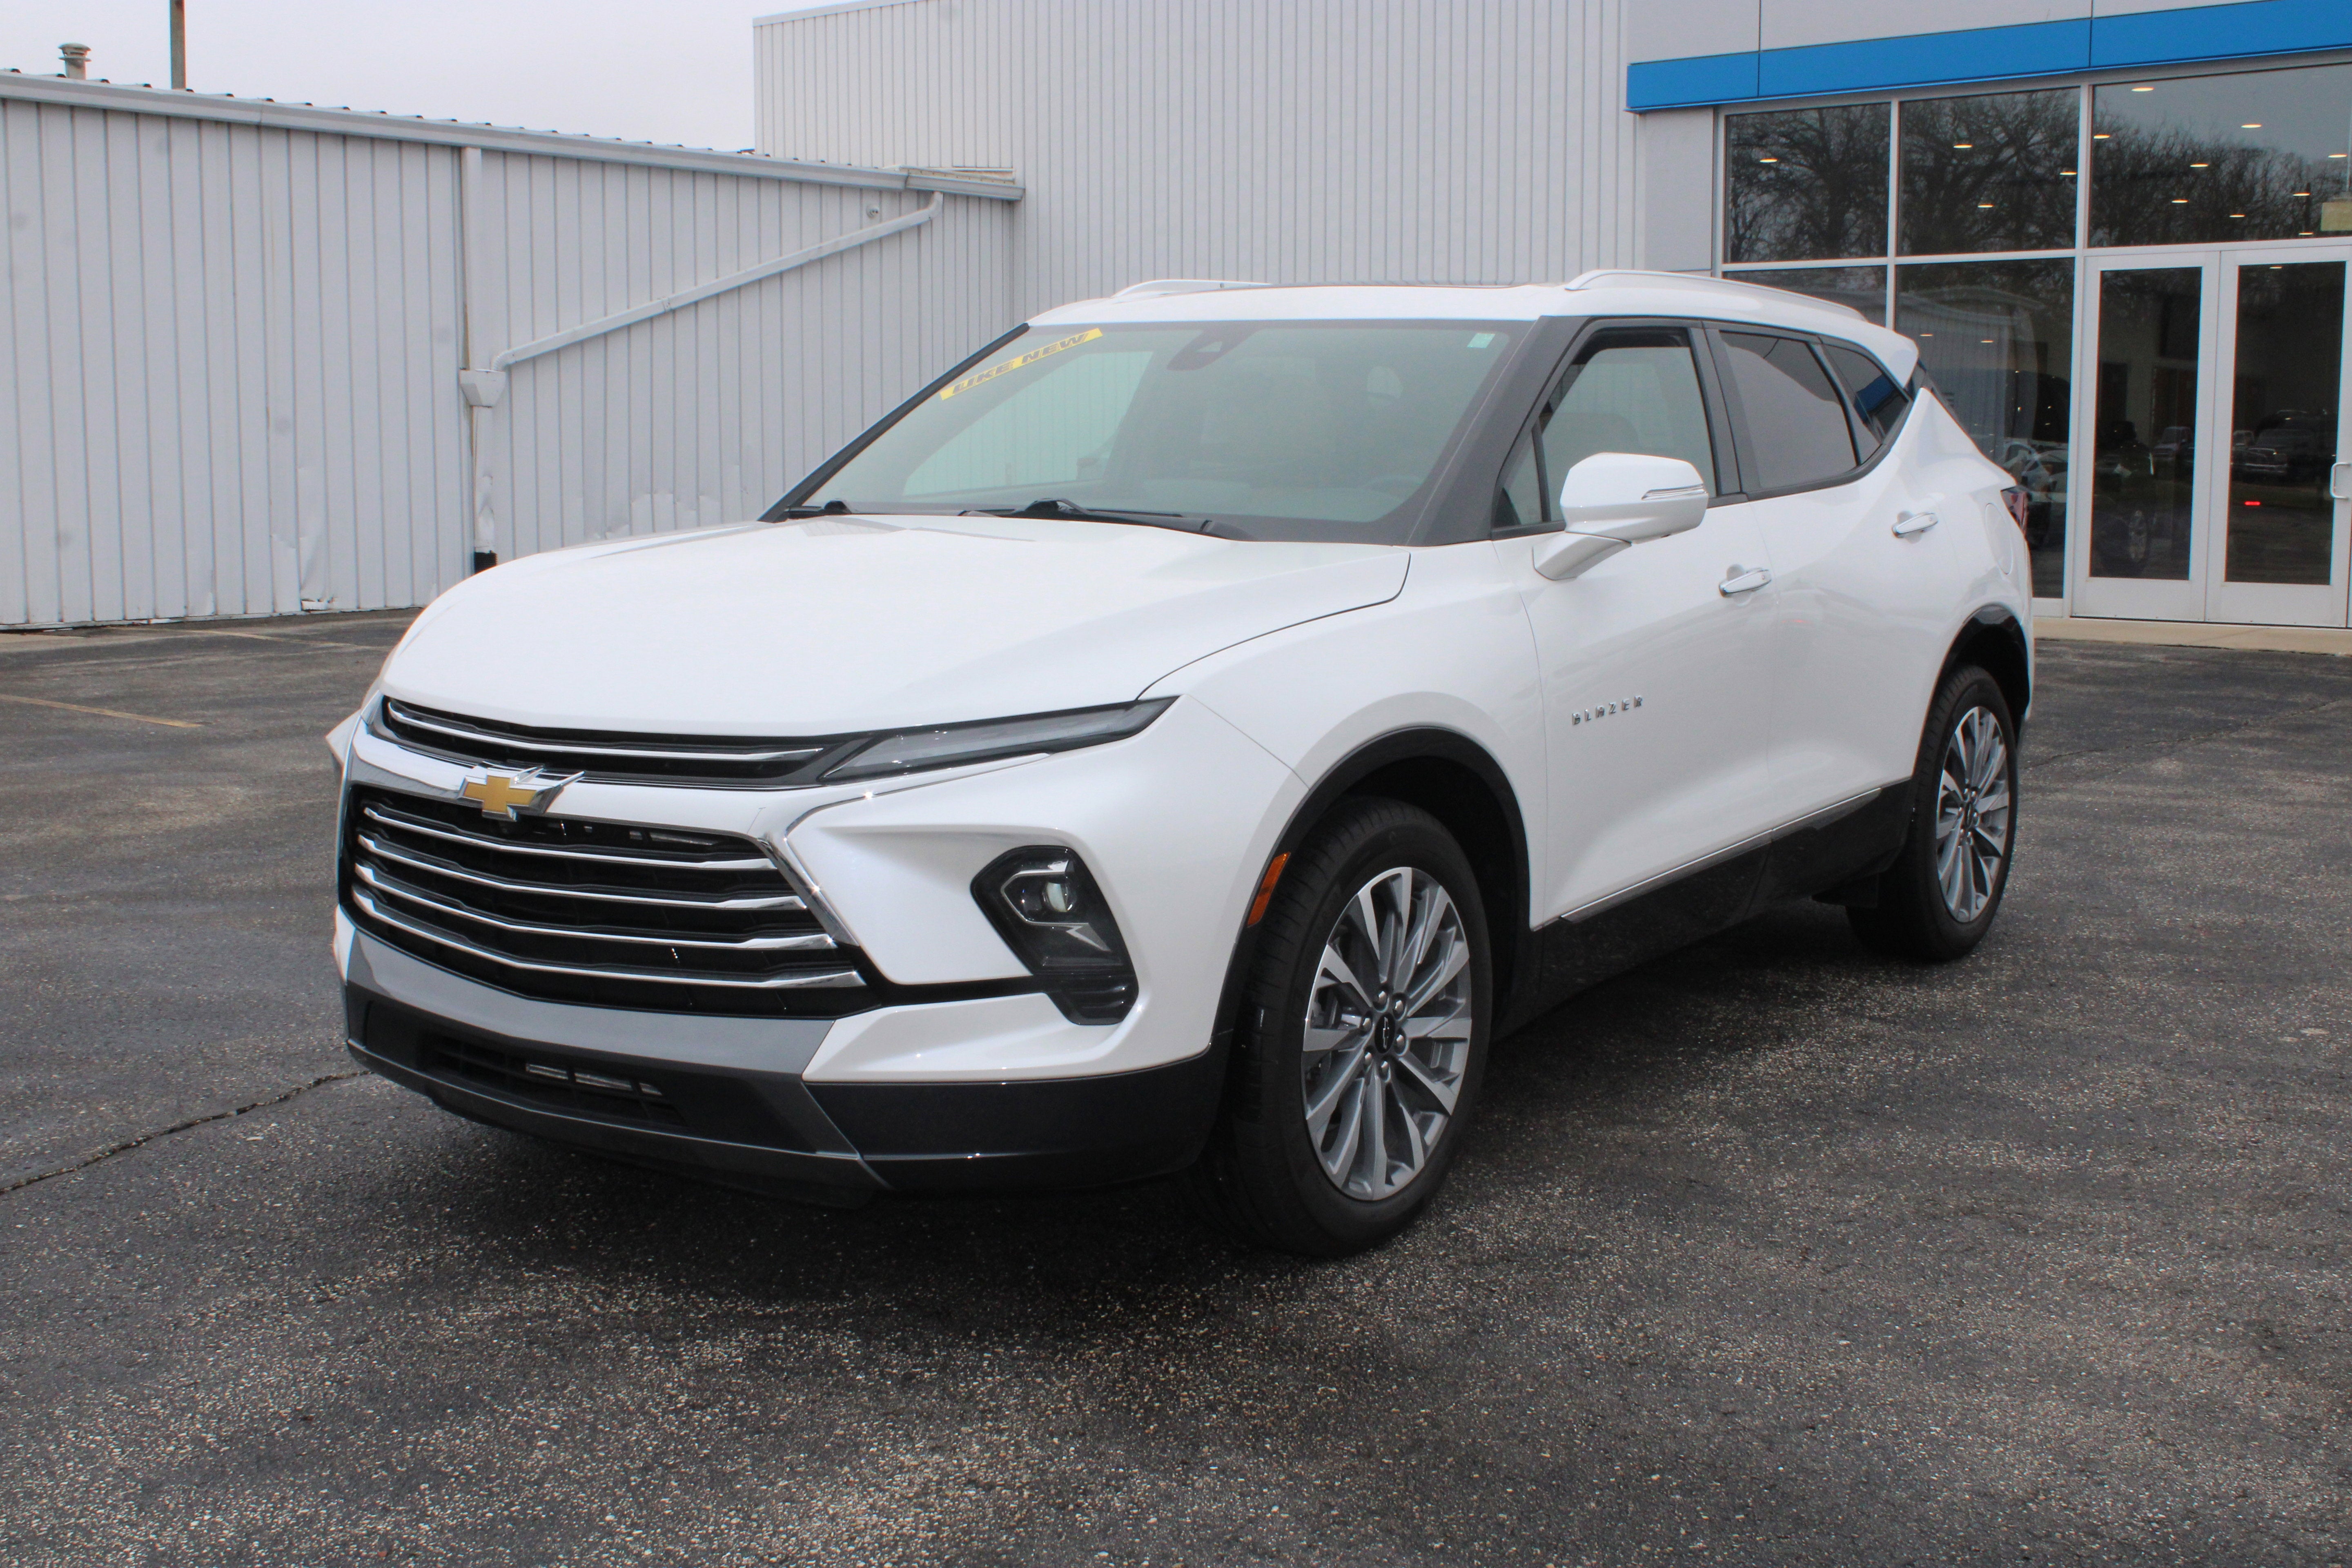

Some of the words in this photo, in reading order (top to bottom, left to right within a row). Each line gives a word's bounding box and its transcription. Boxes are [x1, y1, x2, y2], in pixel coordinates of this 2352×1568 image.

[952, 361, 1015, 395] LIKE
[1022, 332, 1089, 364] NEW
[1572, 695, 1643, 725] BLAZER
